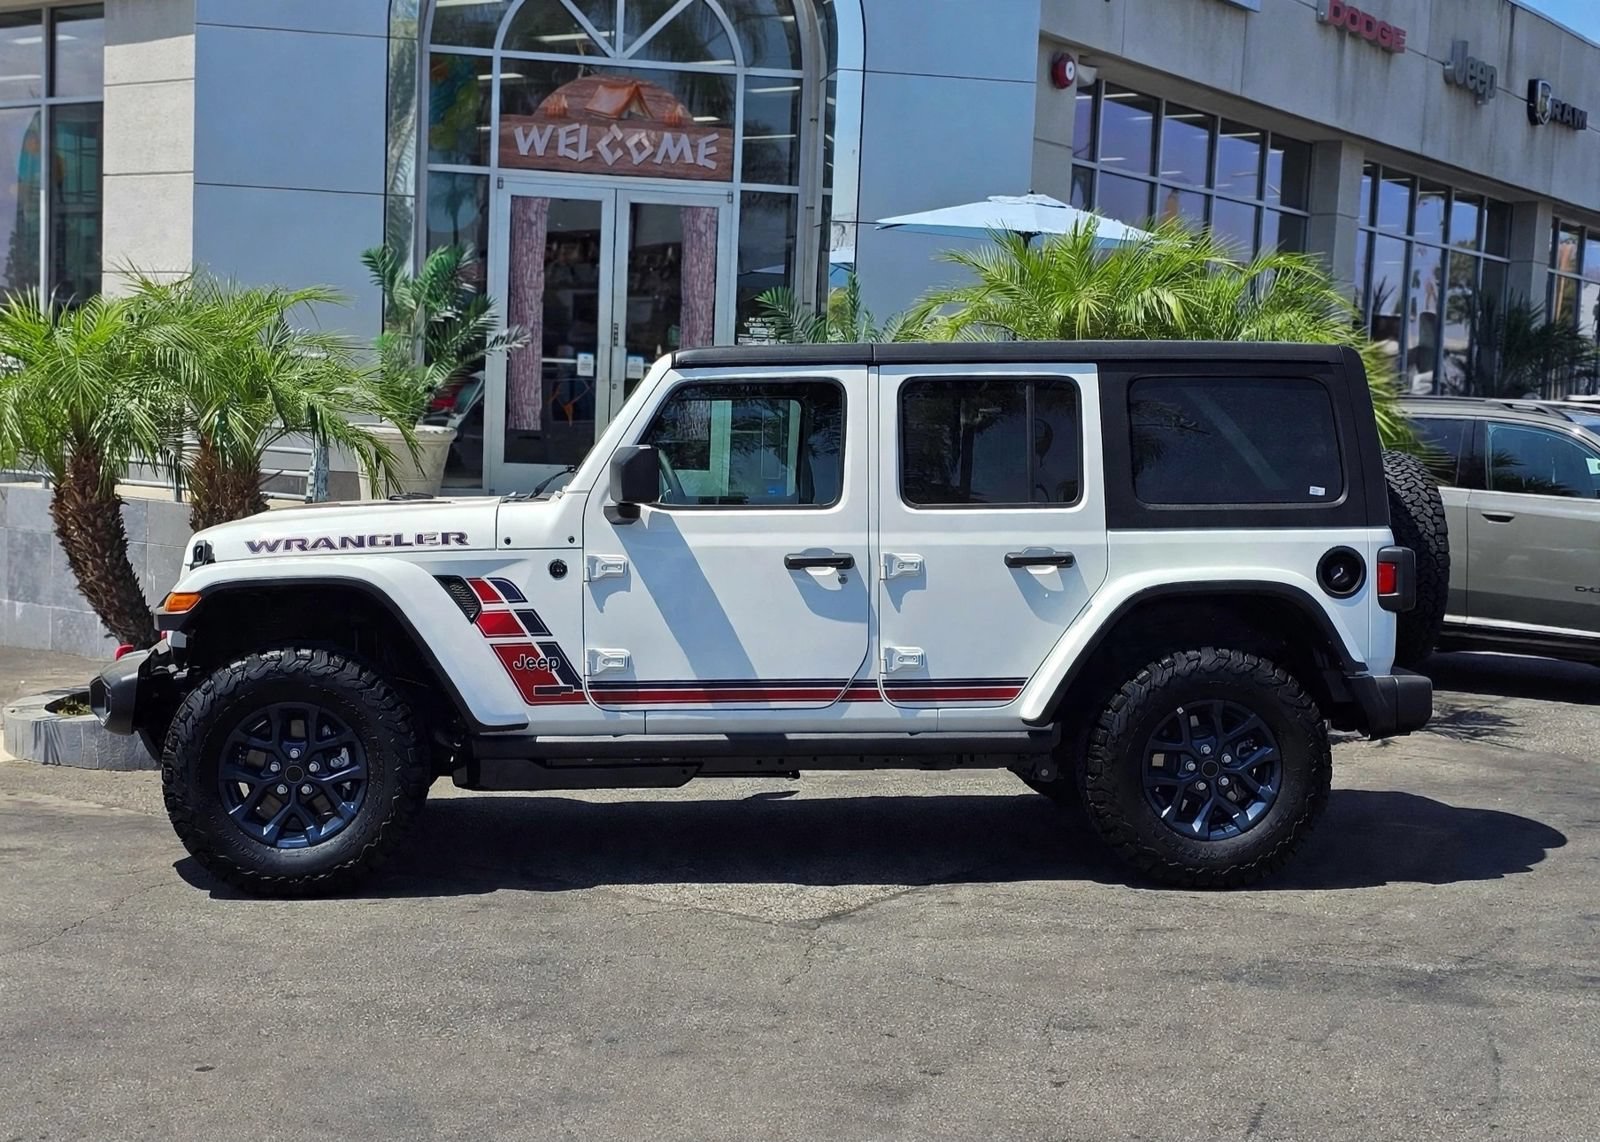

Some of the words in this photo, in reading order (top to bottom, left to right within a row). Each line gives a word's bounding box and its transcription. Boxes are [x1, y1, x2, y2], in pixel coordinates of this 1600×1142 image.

[1328, 0, 1406, 53] DODGE
[1443, 40, 1497, 105] Jeep
[1551, 98, 1587, 130] RAM
[513, 122, 720, 170] WELCOME
[244, 531, 470, 554] WRANGLER
[513, 653, 560, 673] Jeep
